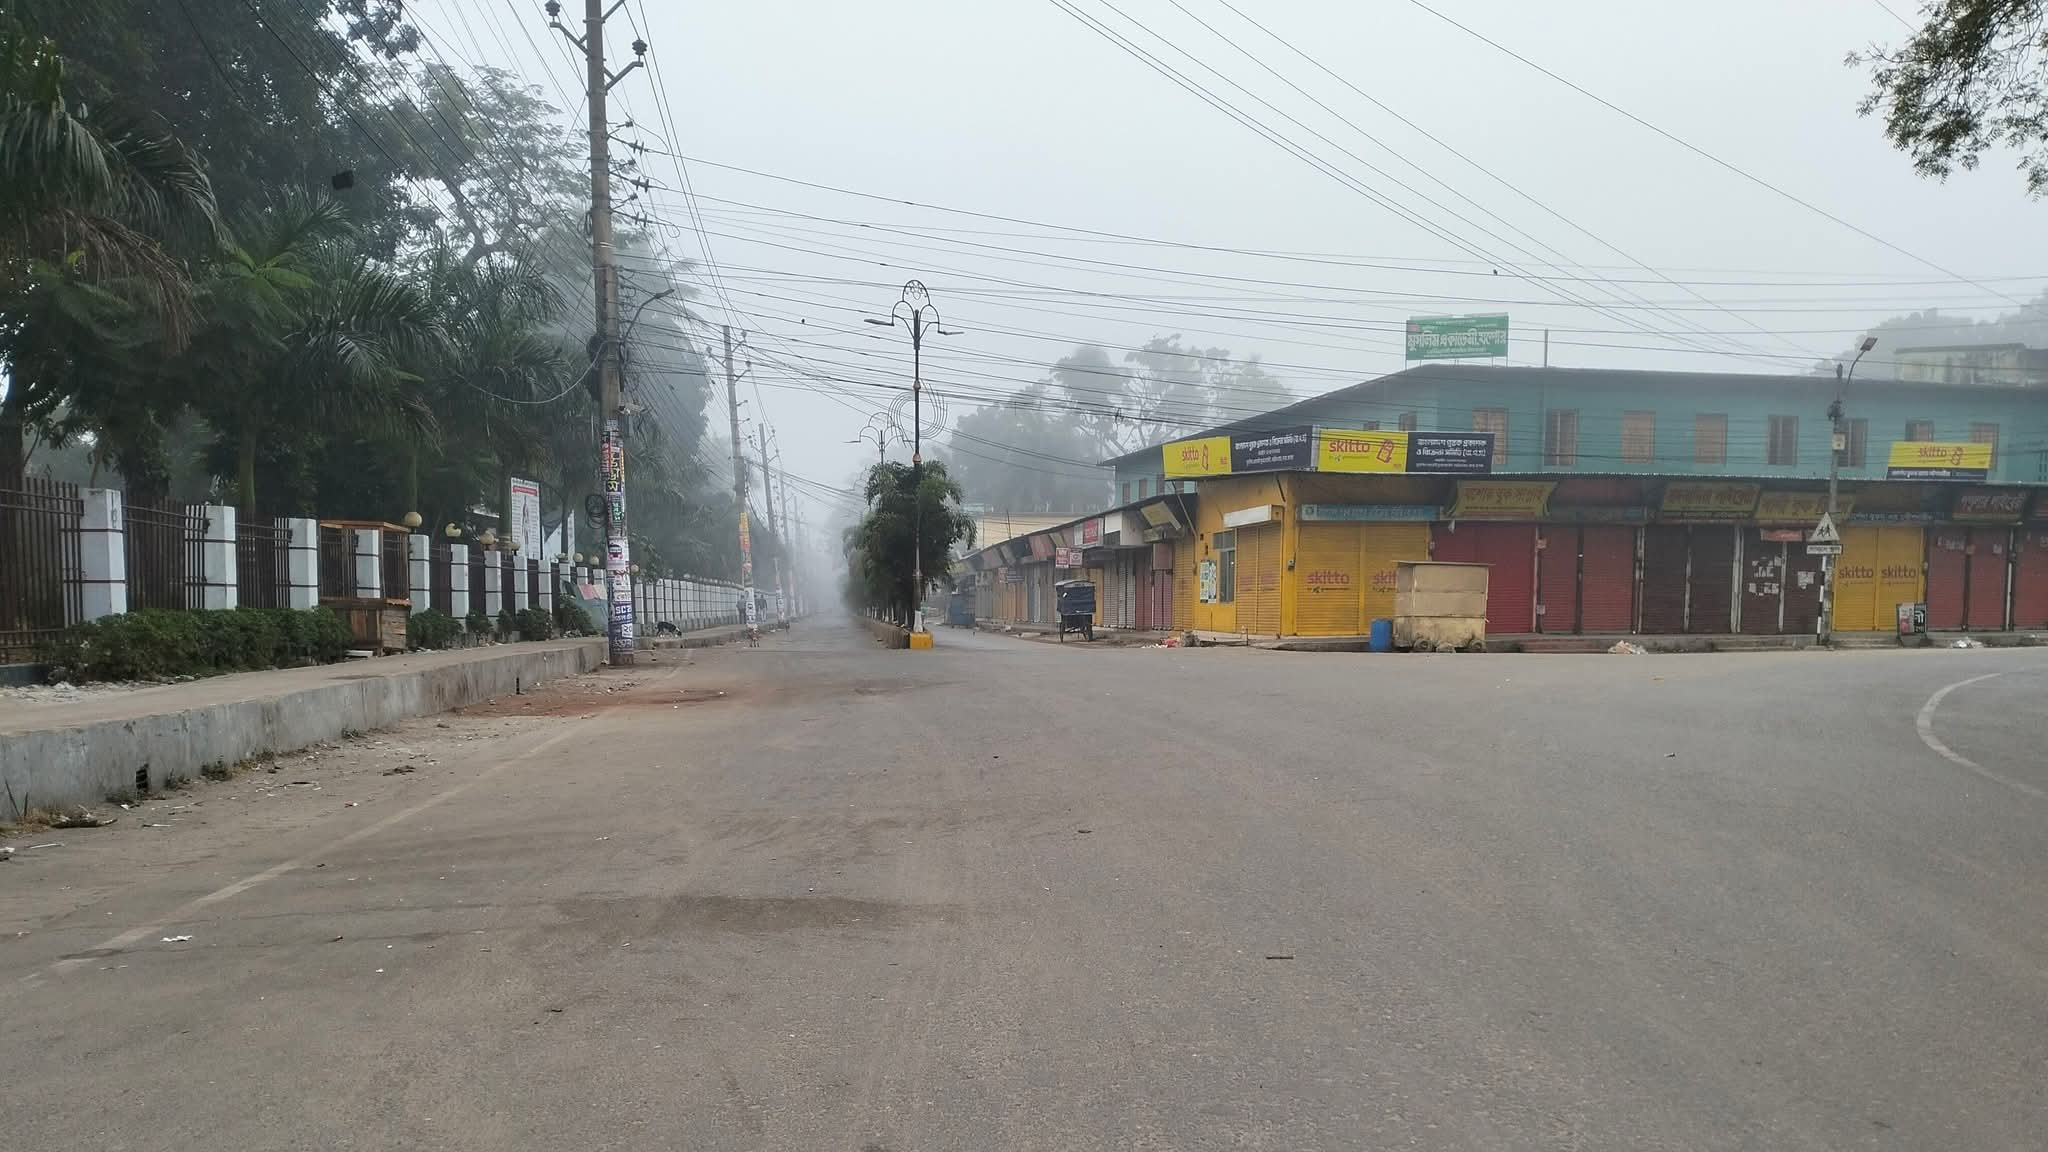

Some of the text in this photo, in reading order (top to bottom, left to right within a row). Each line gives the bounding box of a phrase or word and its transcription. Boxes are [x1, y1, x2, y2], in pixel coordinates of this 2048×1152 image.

[1328, 439, 1370, 452] skitto
[1182, 444, 1200, 462] skitto
[1919, 447, 1947, 458] skitto
[1308, 570, 1350, 584] skitto
[1839, 566, 1874, 579] skitto
[1881, 565, 1916, 578] skitto
